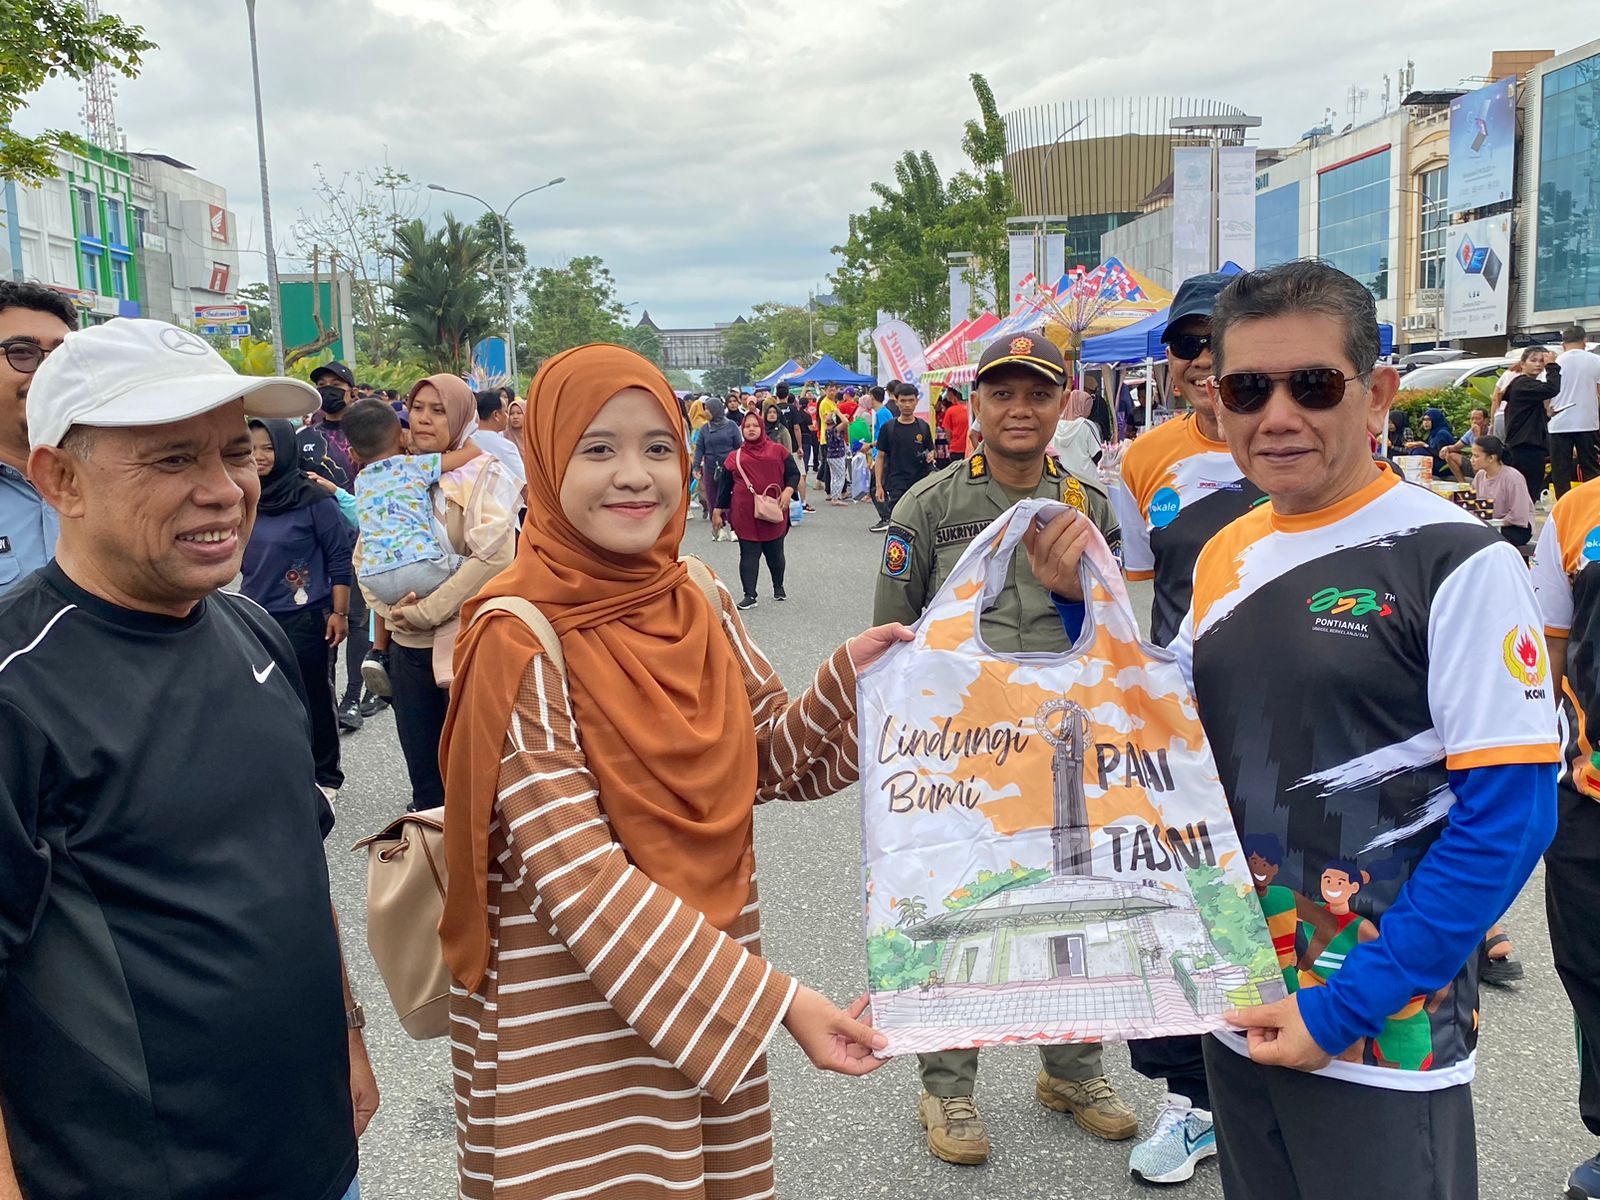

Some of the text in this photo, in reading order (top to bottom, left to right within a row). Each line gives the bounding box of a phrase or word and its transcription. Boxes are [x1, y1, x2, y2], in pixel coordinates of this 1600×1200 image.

[1315, 617, 1369, 633] PONTIANAK
[877, 714, 1029, 766] Lindungi
[880, 774, 981, 813] Bumi
